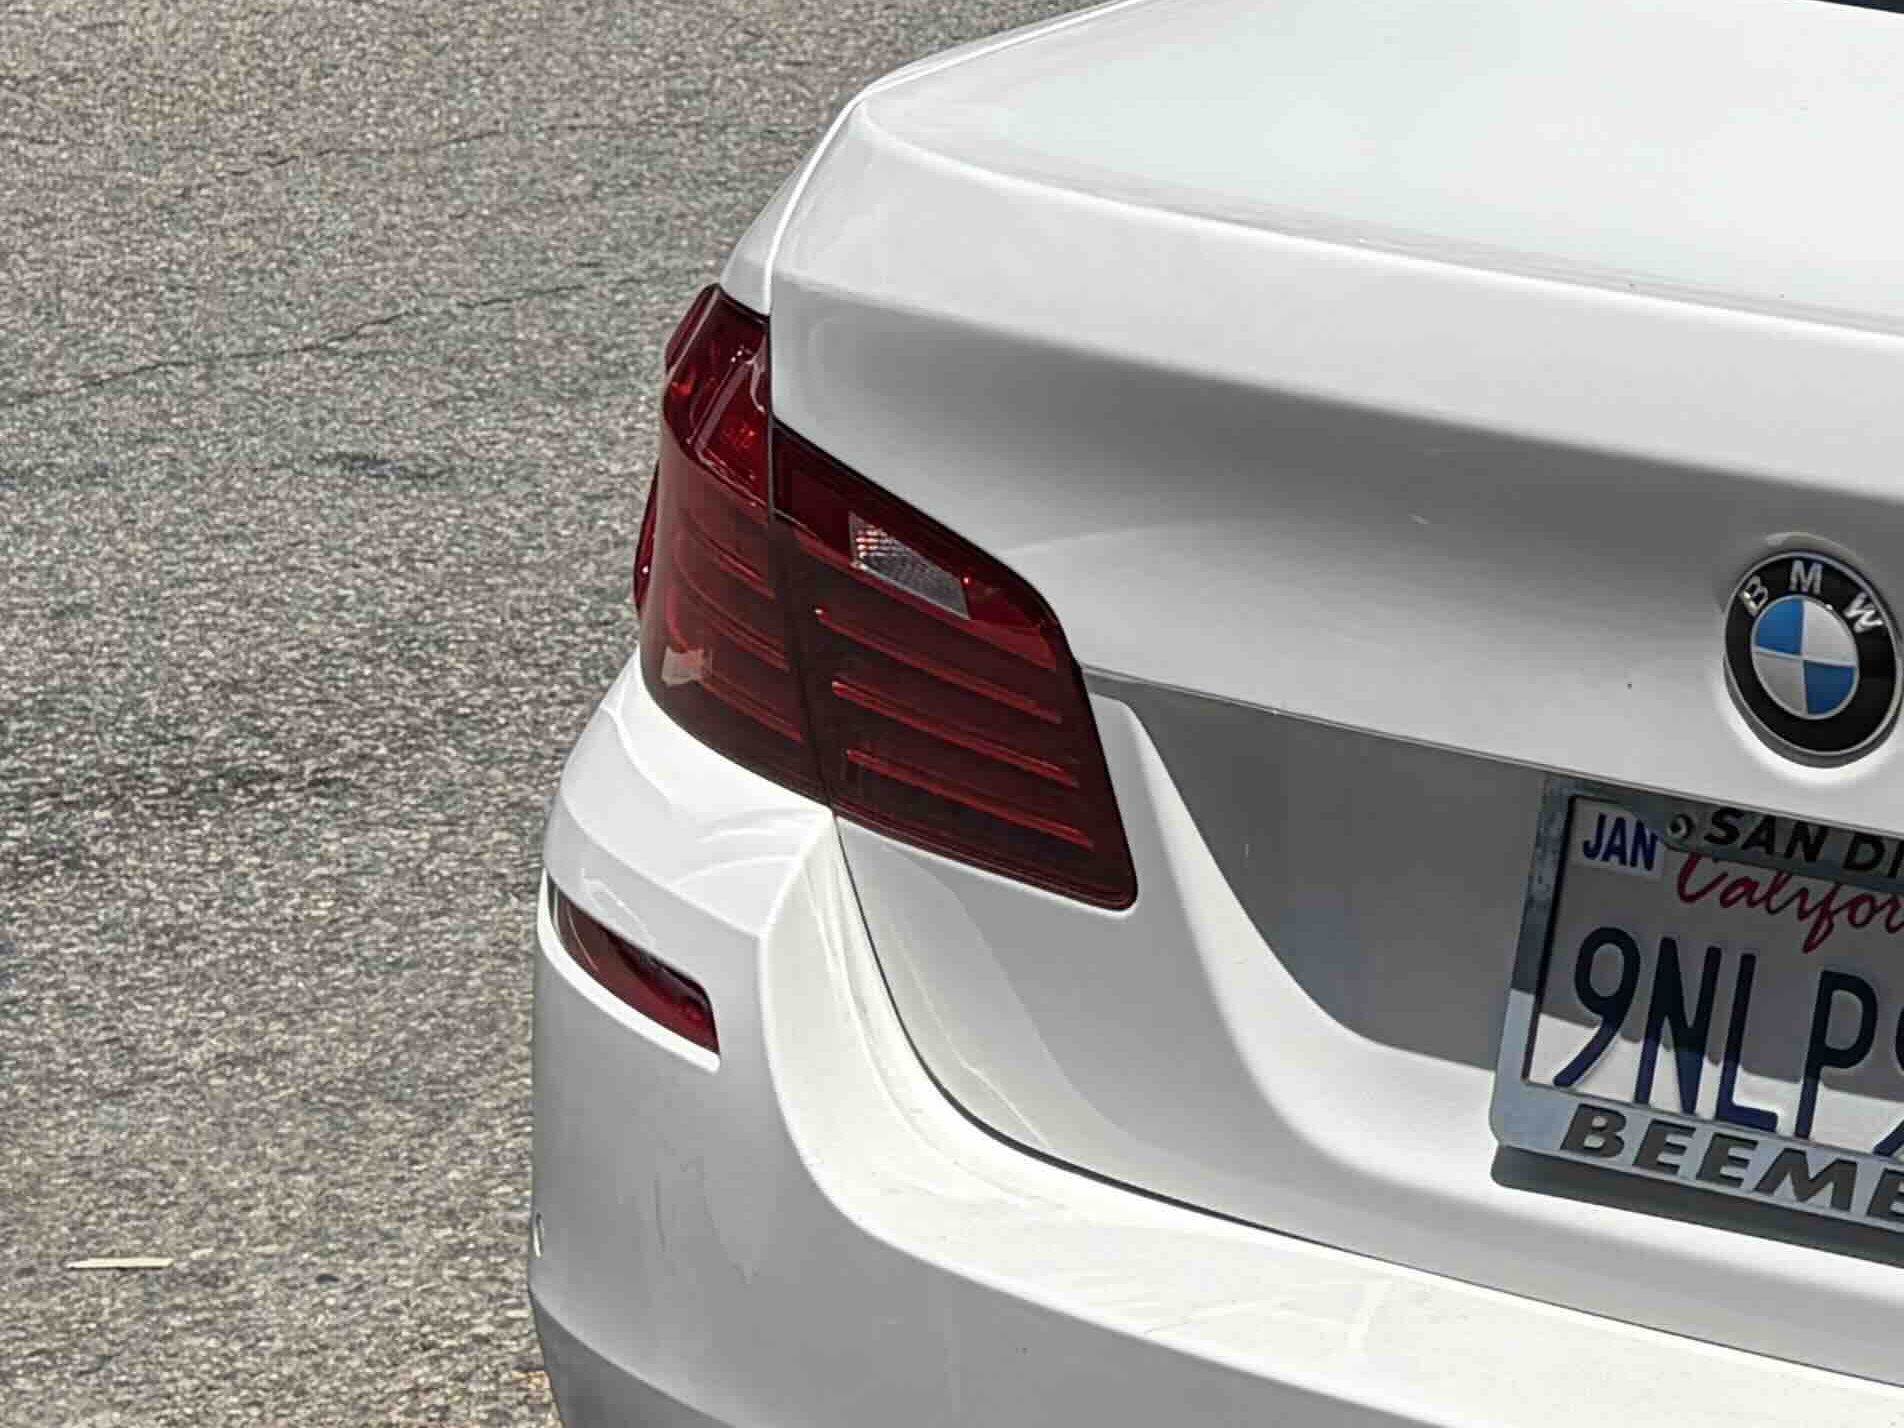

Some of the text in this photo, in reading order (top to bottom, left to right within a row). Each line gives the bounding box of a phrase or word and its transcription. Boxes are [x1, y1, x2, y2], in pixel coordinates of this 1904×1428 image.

[1739, 558, 1885, 635] BMW
[1582, 812, 1661, 872] JAN
[1703, 806, 1831, 864] SAN
